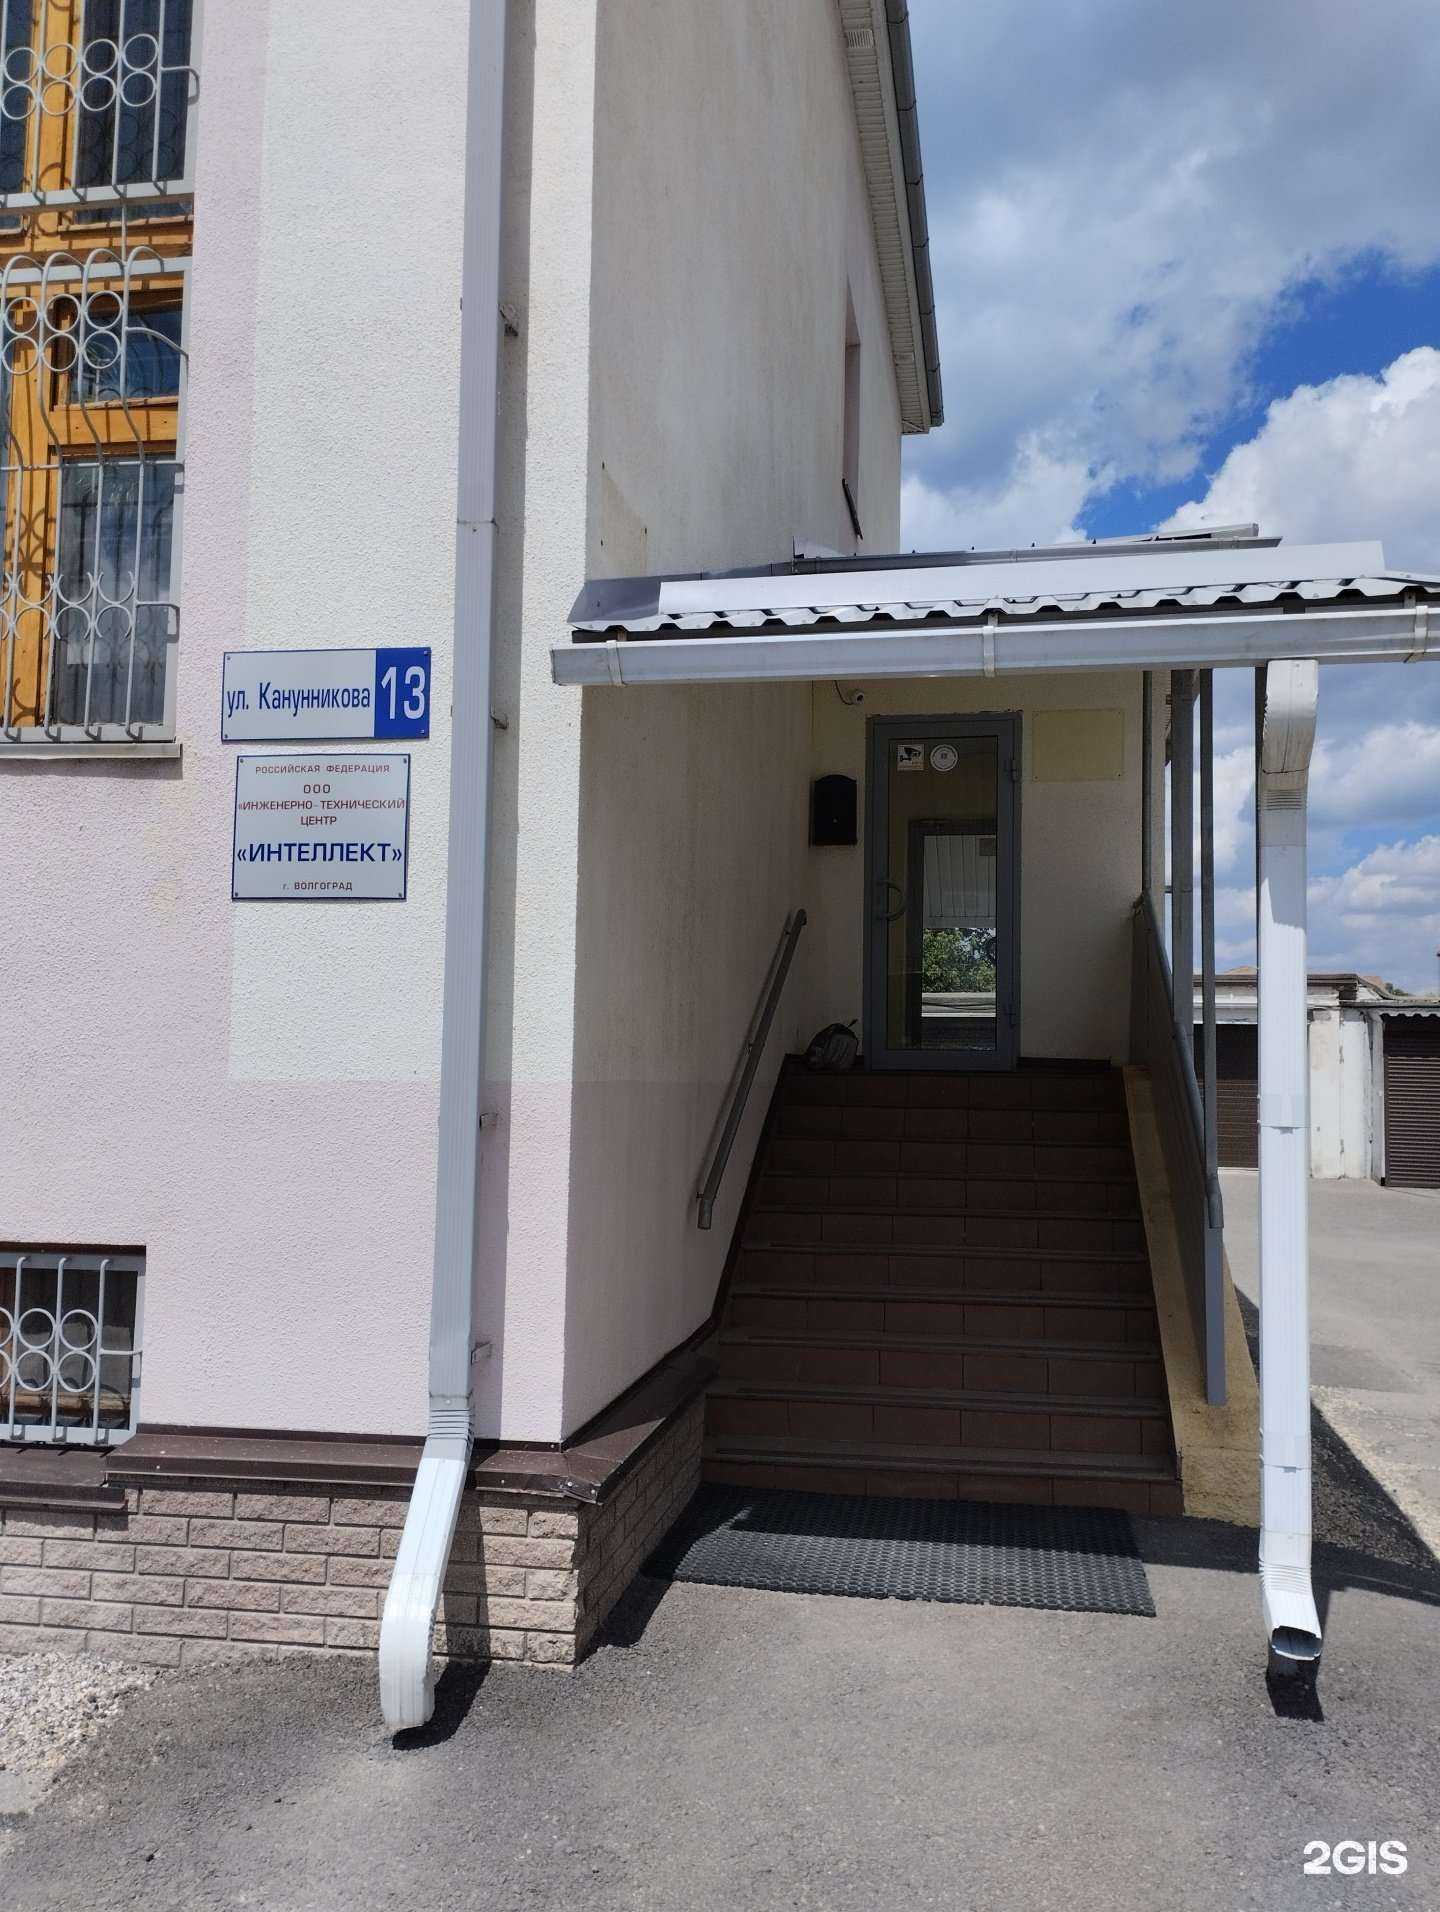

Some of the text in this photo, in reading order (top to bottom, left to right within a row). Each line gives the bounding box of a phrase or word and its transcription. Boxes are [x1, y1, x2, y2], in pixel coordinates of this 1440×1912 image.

[227, 666, 426, 720] ул. Канунникова 13
[255, 763, 391, 775] РОССИЙСКАЯ ФЕДЕРАЦИЯ
[303, 783, 332, 794] ООО
[300, 815, 338, 827] ЦЕНТР
[237, 843, 403, 863] «ИНТЕЛЛЕКТ»
[294, 881, 354, 892] ВОЛГОГРАД
